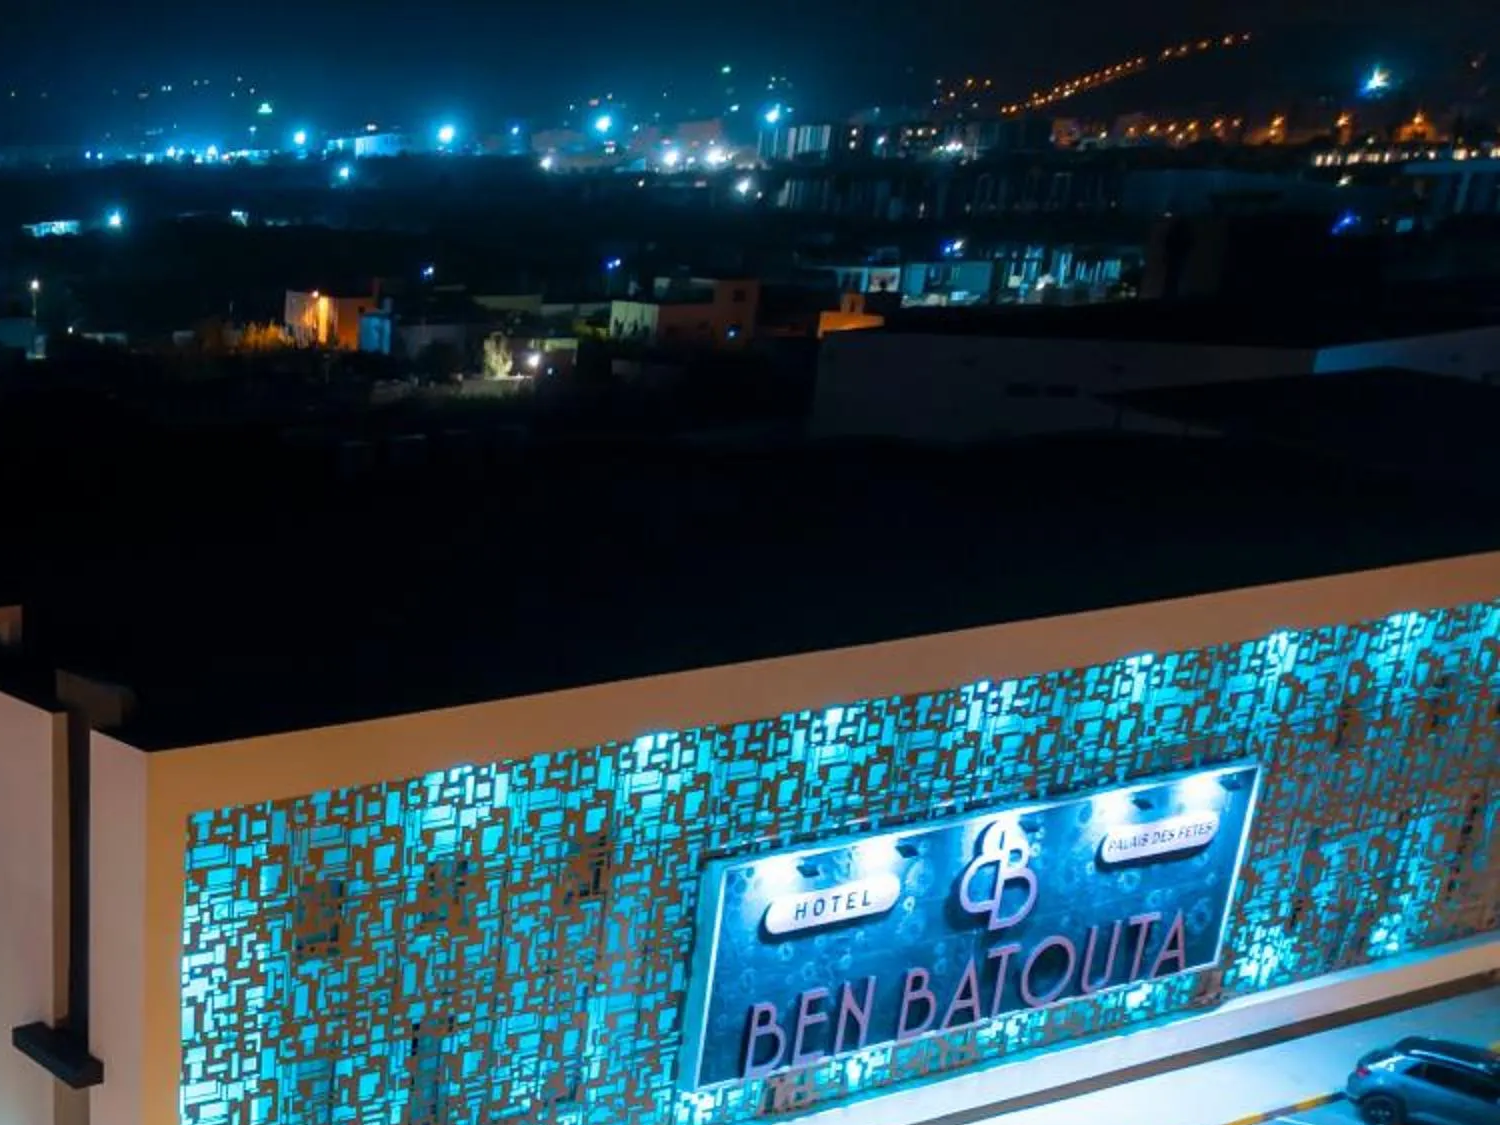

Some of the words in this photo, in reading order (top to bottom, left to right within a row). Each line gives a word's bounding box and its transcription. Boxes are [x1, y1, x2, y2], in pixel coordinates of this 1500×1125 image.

[794, 890, 872, 921] HOTEL
[744, 975, 876, 1078] BEN
[896, 908, 1186, 1041] BATOUTA
